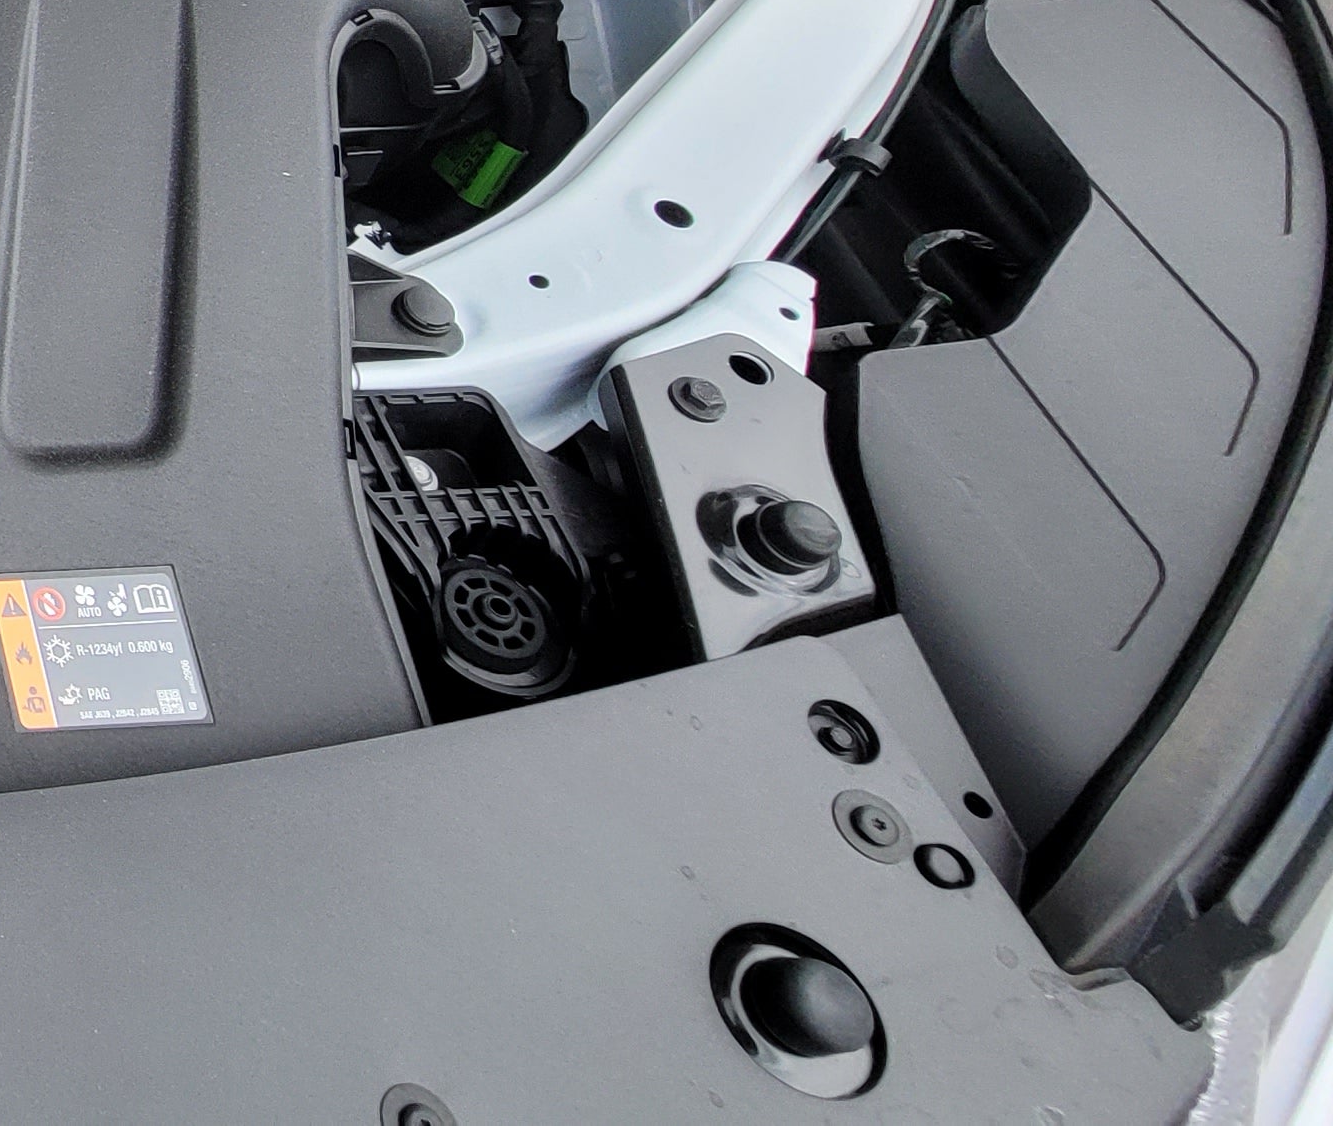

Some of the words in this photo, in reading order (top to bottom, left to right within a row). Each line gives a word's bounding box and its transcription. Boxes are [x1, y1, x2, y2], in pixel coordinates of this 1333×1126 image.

[77, 606, 102, 618] AUTO
[76, 641, 123, 657] R-1234yf
[128, 640, 158, 653] 0.600
[159, 639, 174, 654] kg
[87, 687, 111, 701] PAG
